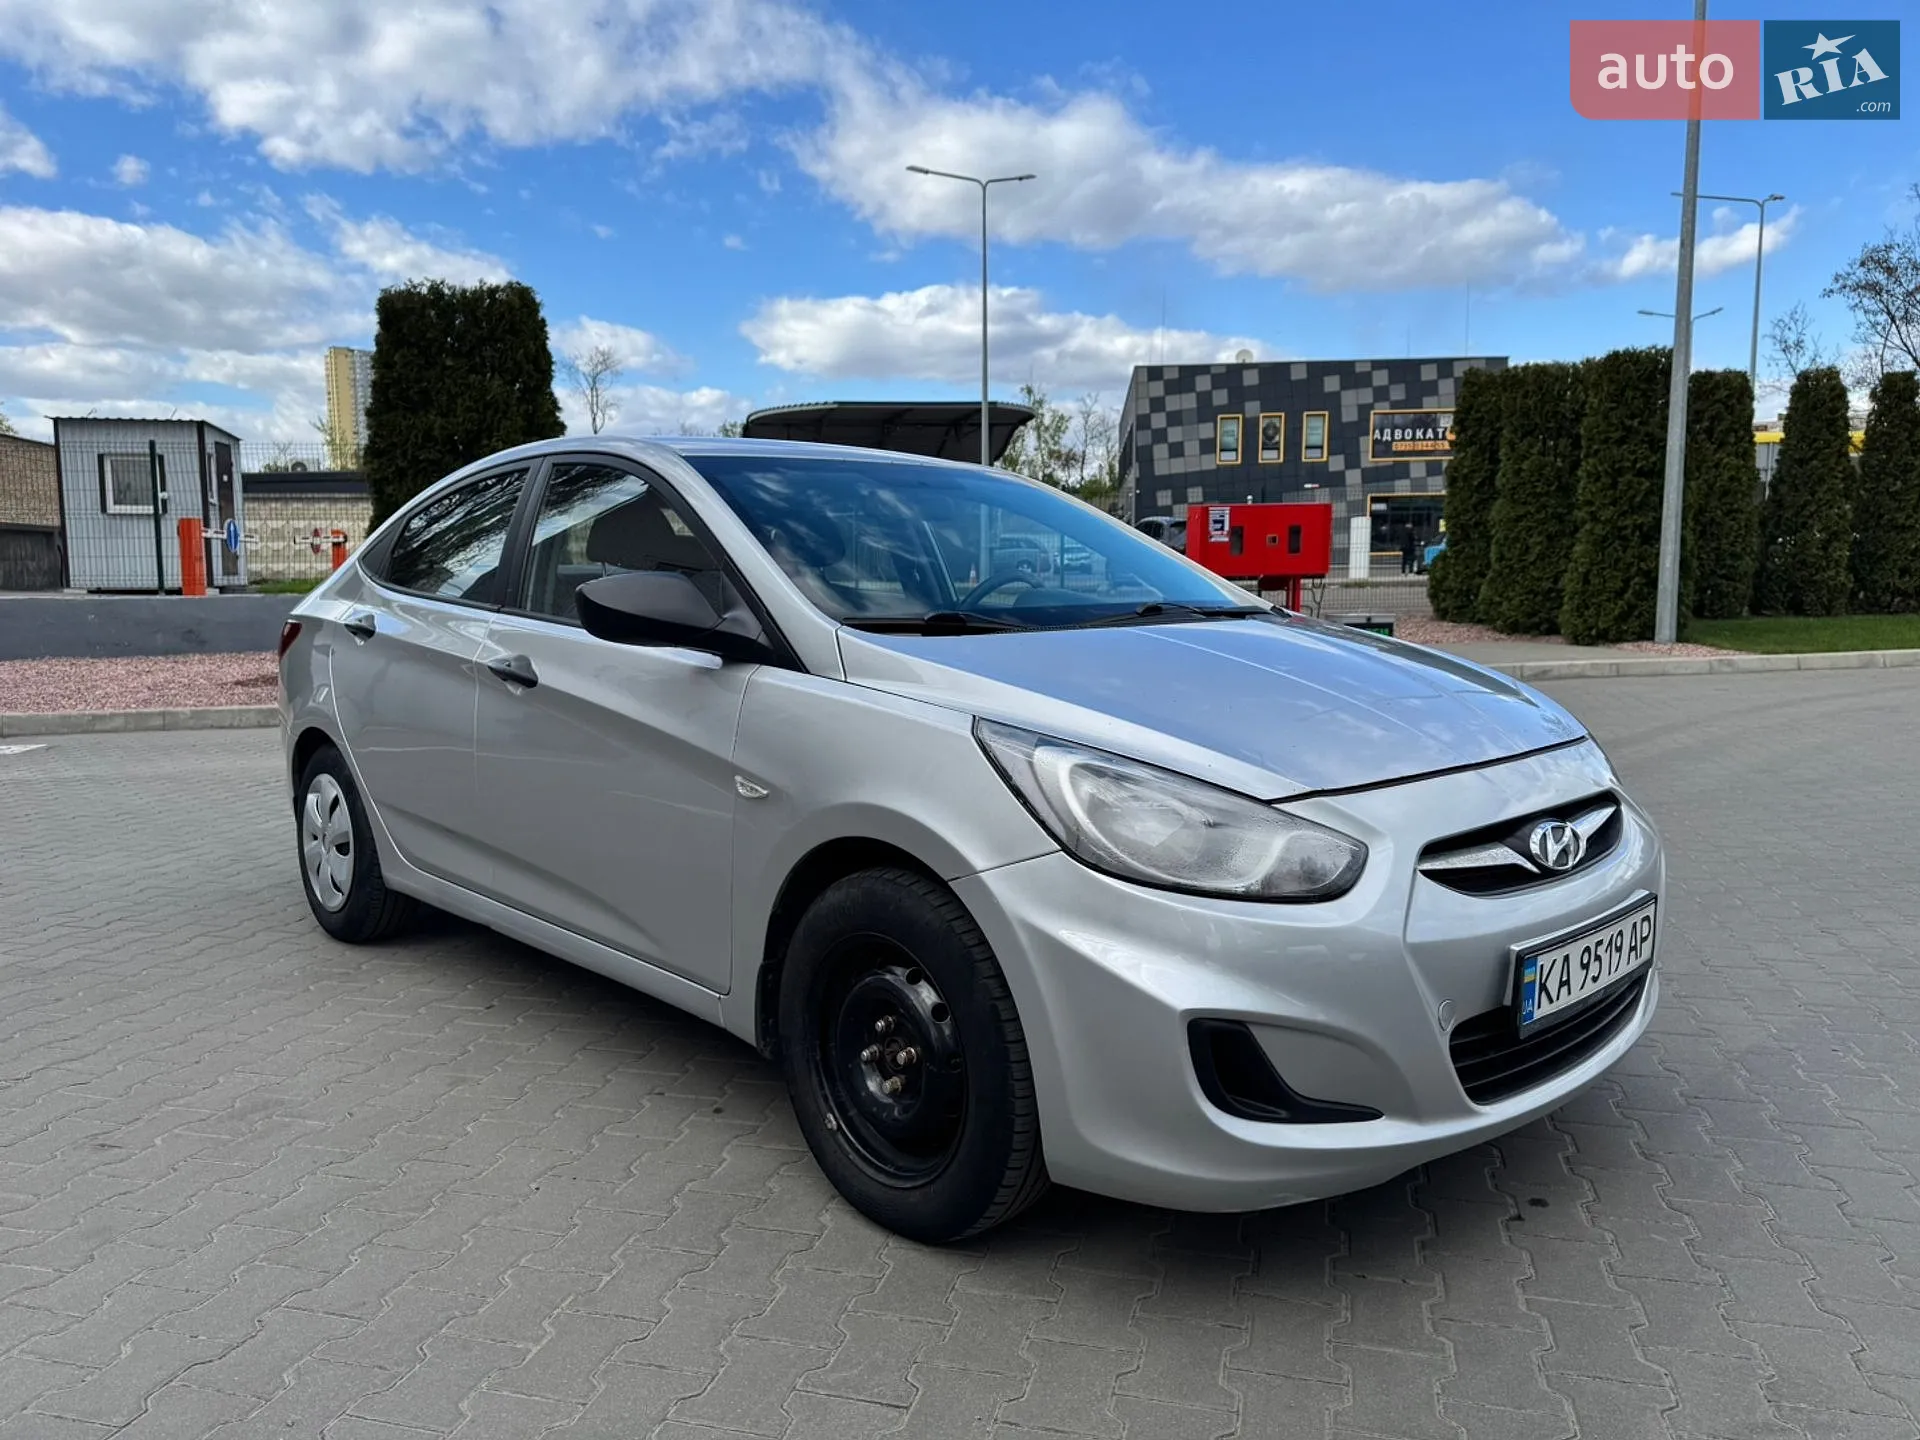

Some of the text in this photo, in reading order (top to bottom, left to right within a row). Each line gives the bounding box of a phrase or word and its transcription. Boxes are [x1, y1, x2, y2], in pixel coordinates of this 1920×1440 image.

[1537, 915, 1652, 1009] KA 9519 AP
